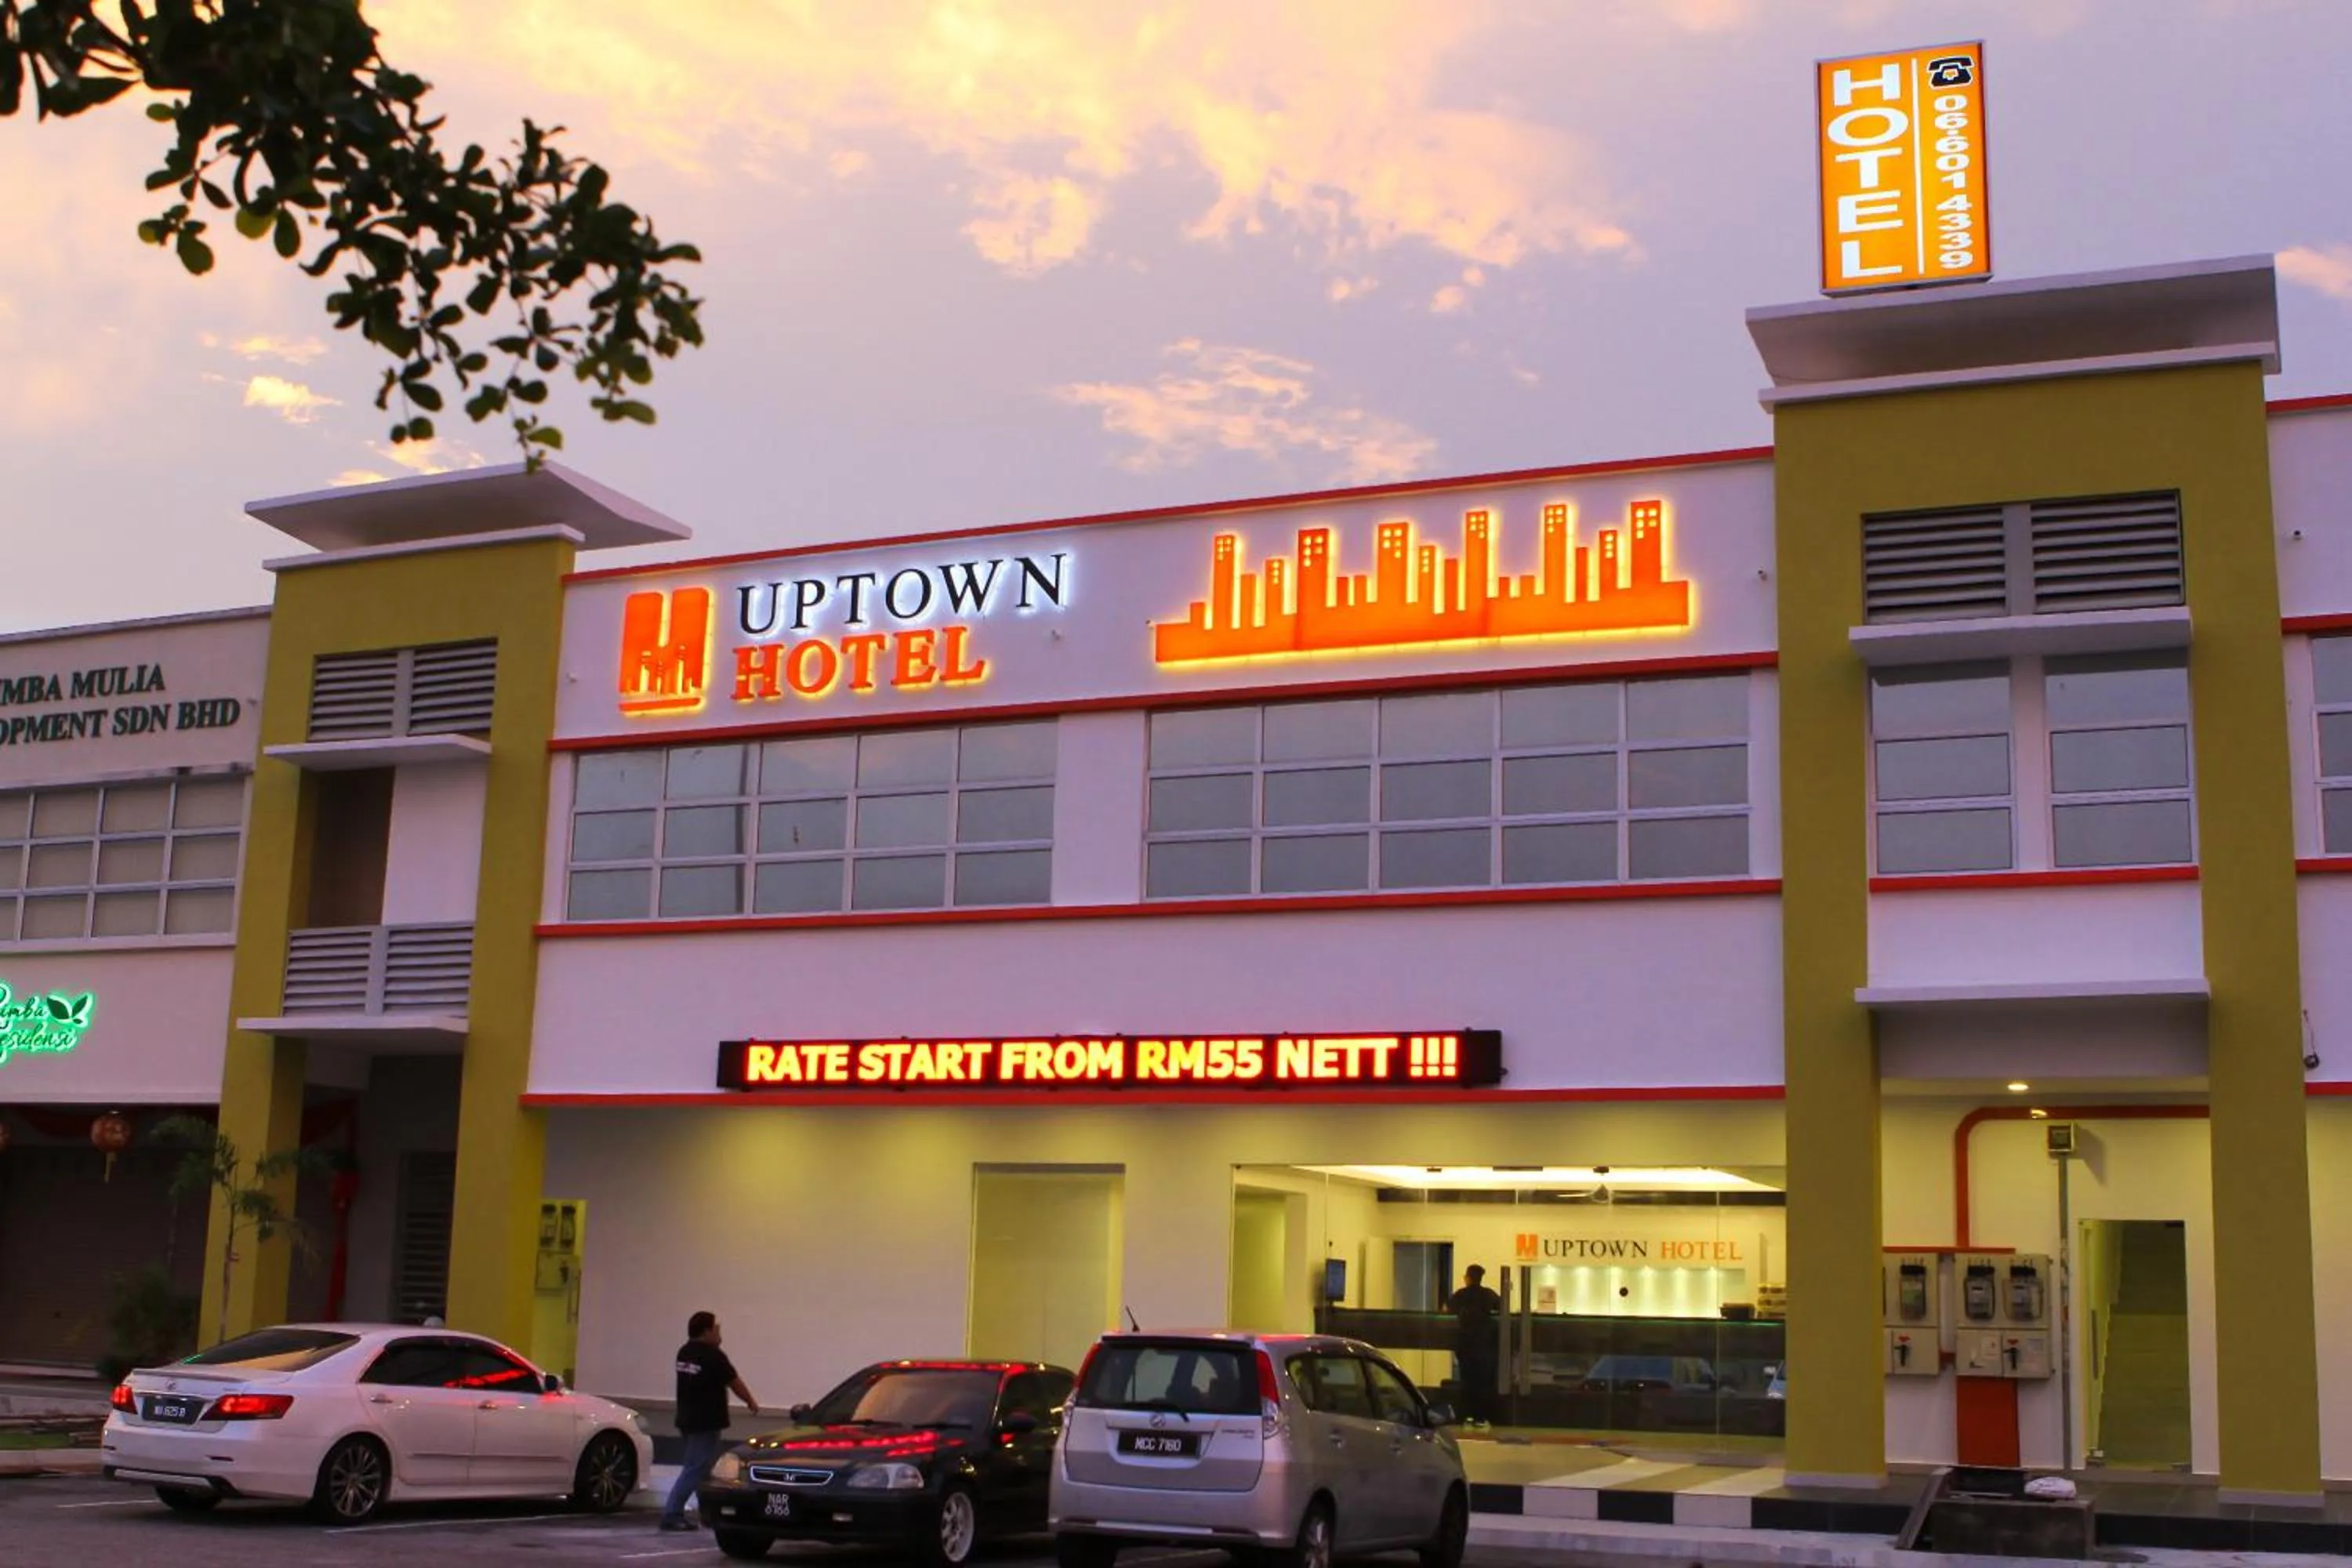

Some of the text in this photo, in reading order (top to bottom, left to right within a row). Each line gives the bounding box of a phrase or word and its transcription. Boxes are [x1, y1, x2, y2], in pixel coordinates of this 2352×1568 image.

[1828, 63, 1909, 278] HOTEL
[736, 554, 1066, 634] UPTOWN
[0, 662, 165, 706] MBA MULIA
[731, 626, 987, 701] HOTEL
[112, 703, 172, 736] SDN
[176, 698, 241, 730] BHD
[747, 1037, 1457, 1080] RATE START FROM RM55 NETT !!!
[1543, 1240, 1744, 1261] UPTOWN HOTEL
